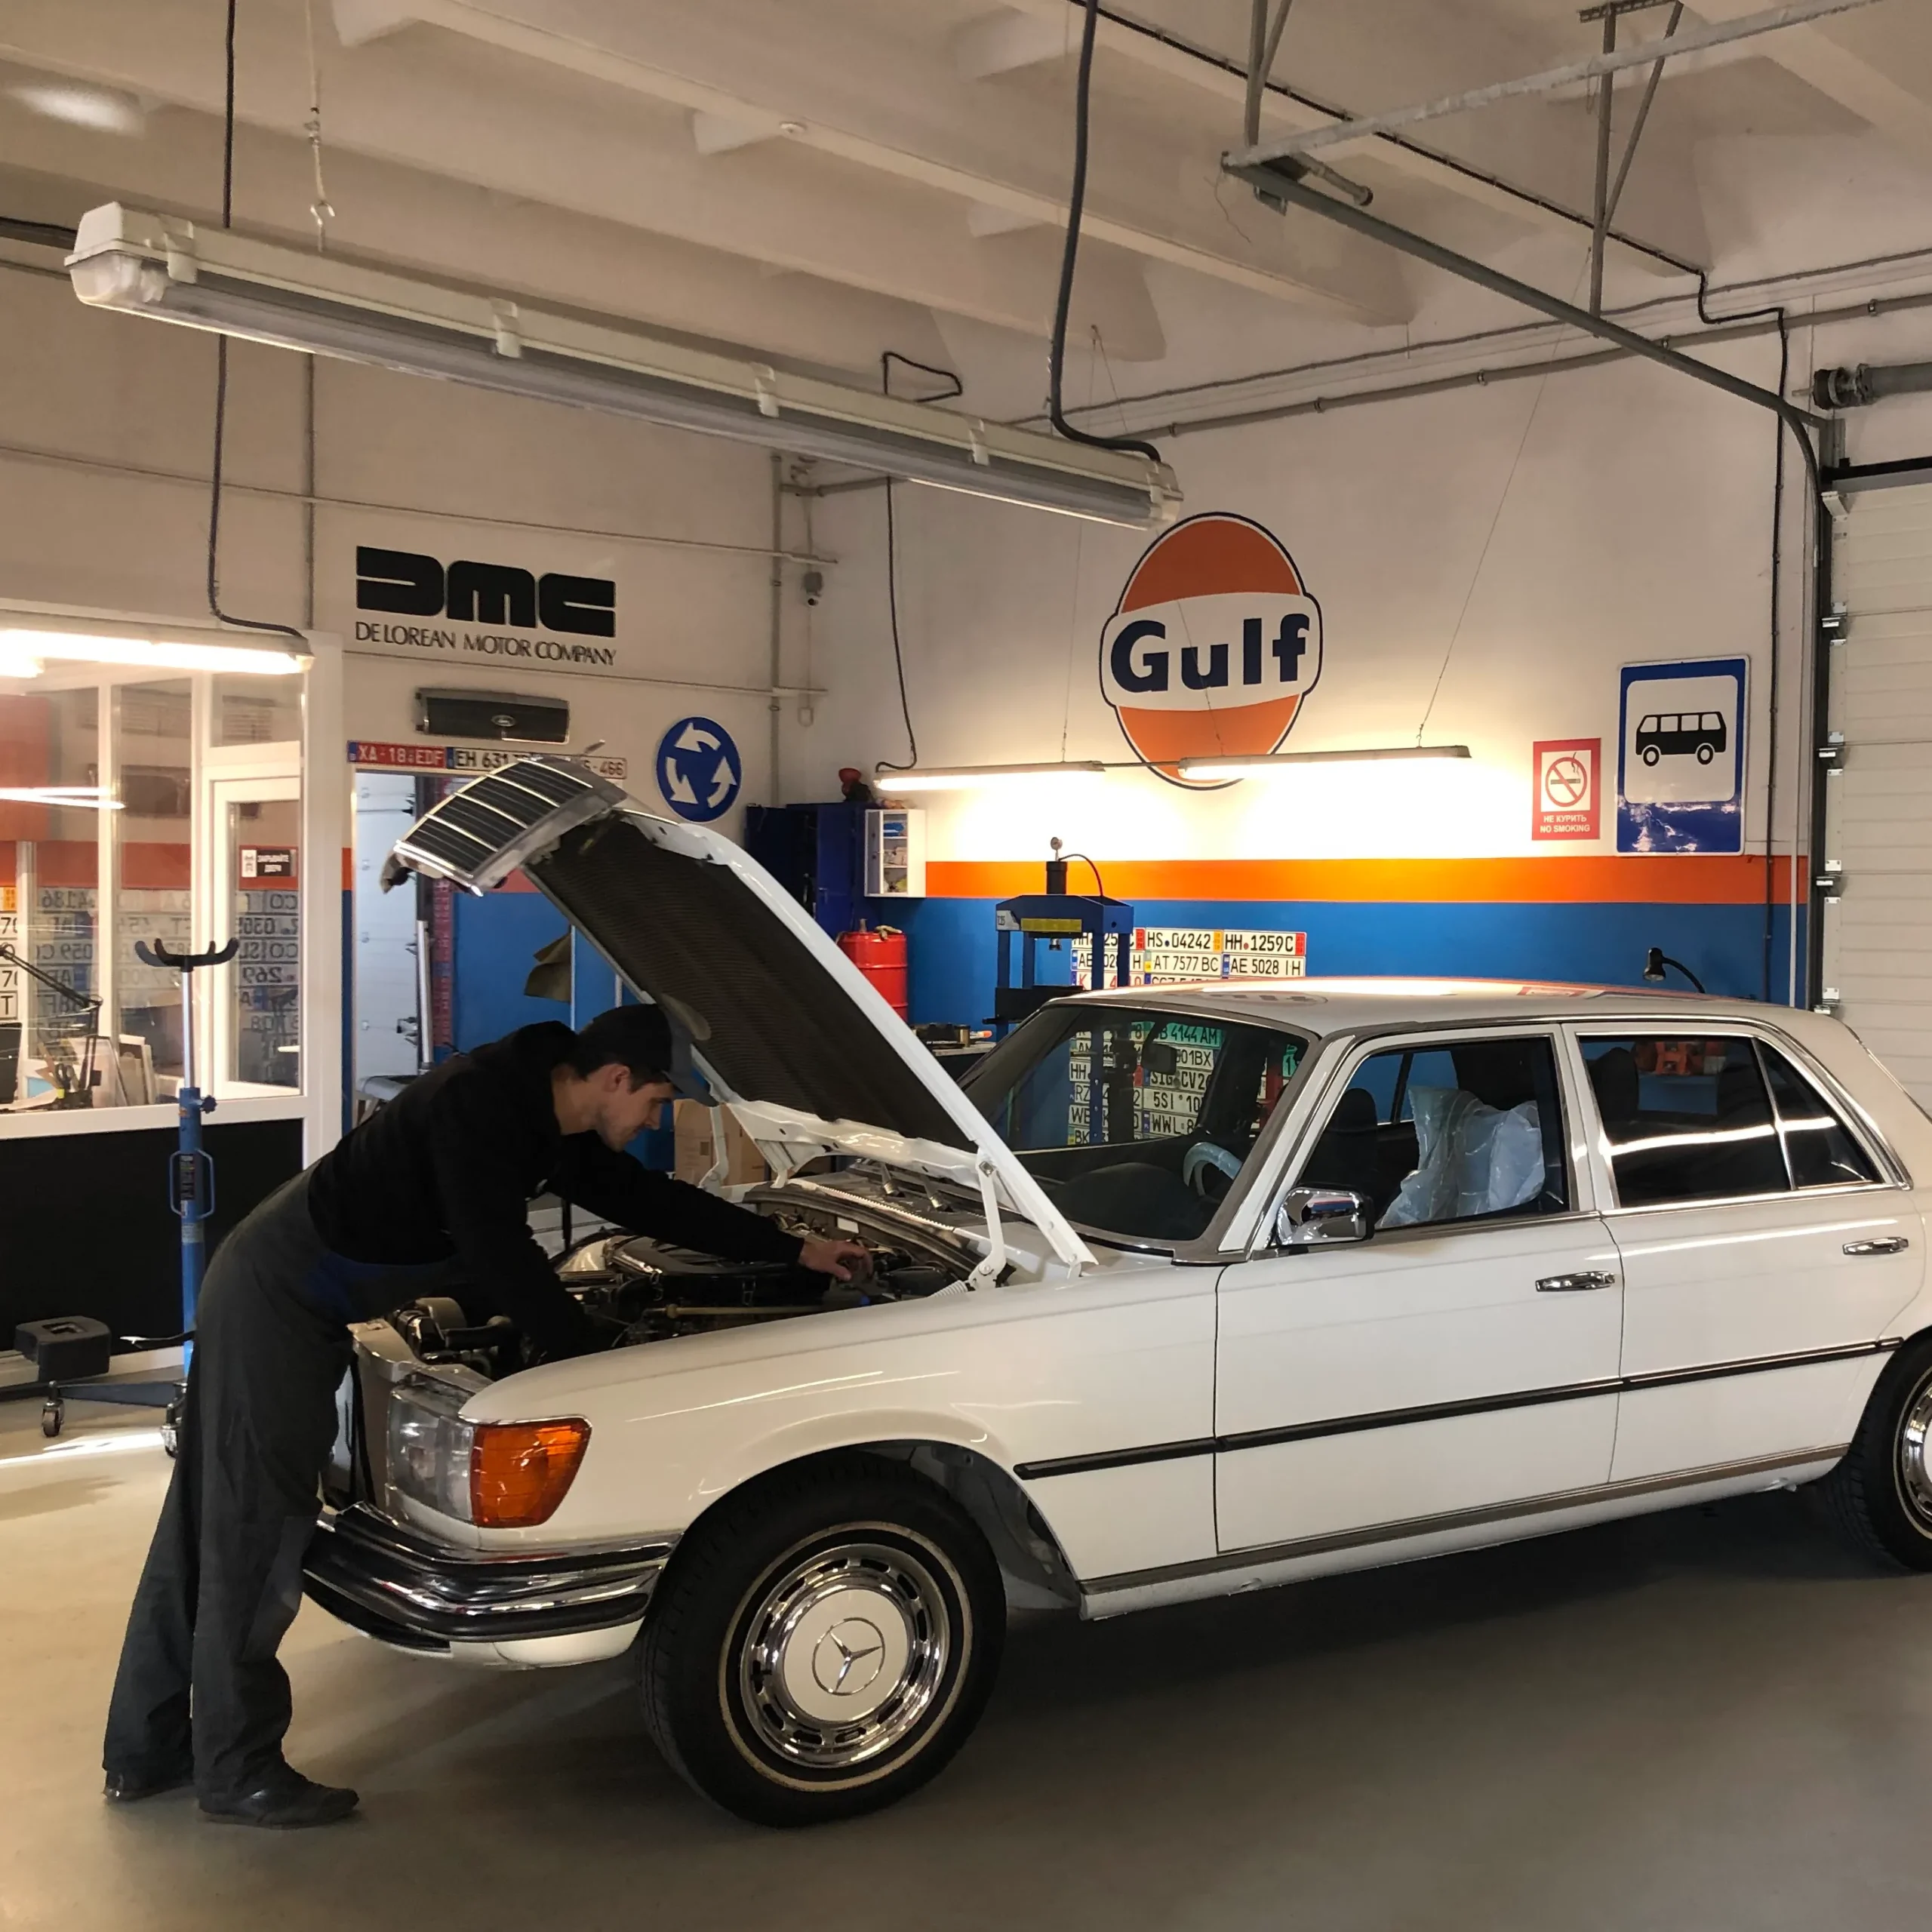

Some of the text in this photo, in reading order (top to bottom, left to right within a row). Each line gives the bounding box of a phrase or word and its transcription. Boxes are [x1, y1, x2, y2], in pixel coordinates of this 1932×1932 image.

[463, 633, 531, 657] MOTOR
[534, 641, 617, 666] COMPANY
[1111, 614, 1309, 693] Gulf
[1556, 814, 1587, 823] КУРИТЬ
[1553, 824, 1590, 832] SMOKING
[1154, 955, 1218, 972] AT 7577 BC
[1231, 958, 1247, 974] AE
[1252, 959, 1279, 975] 5028
